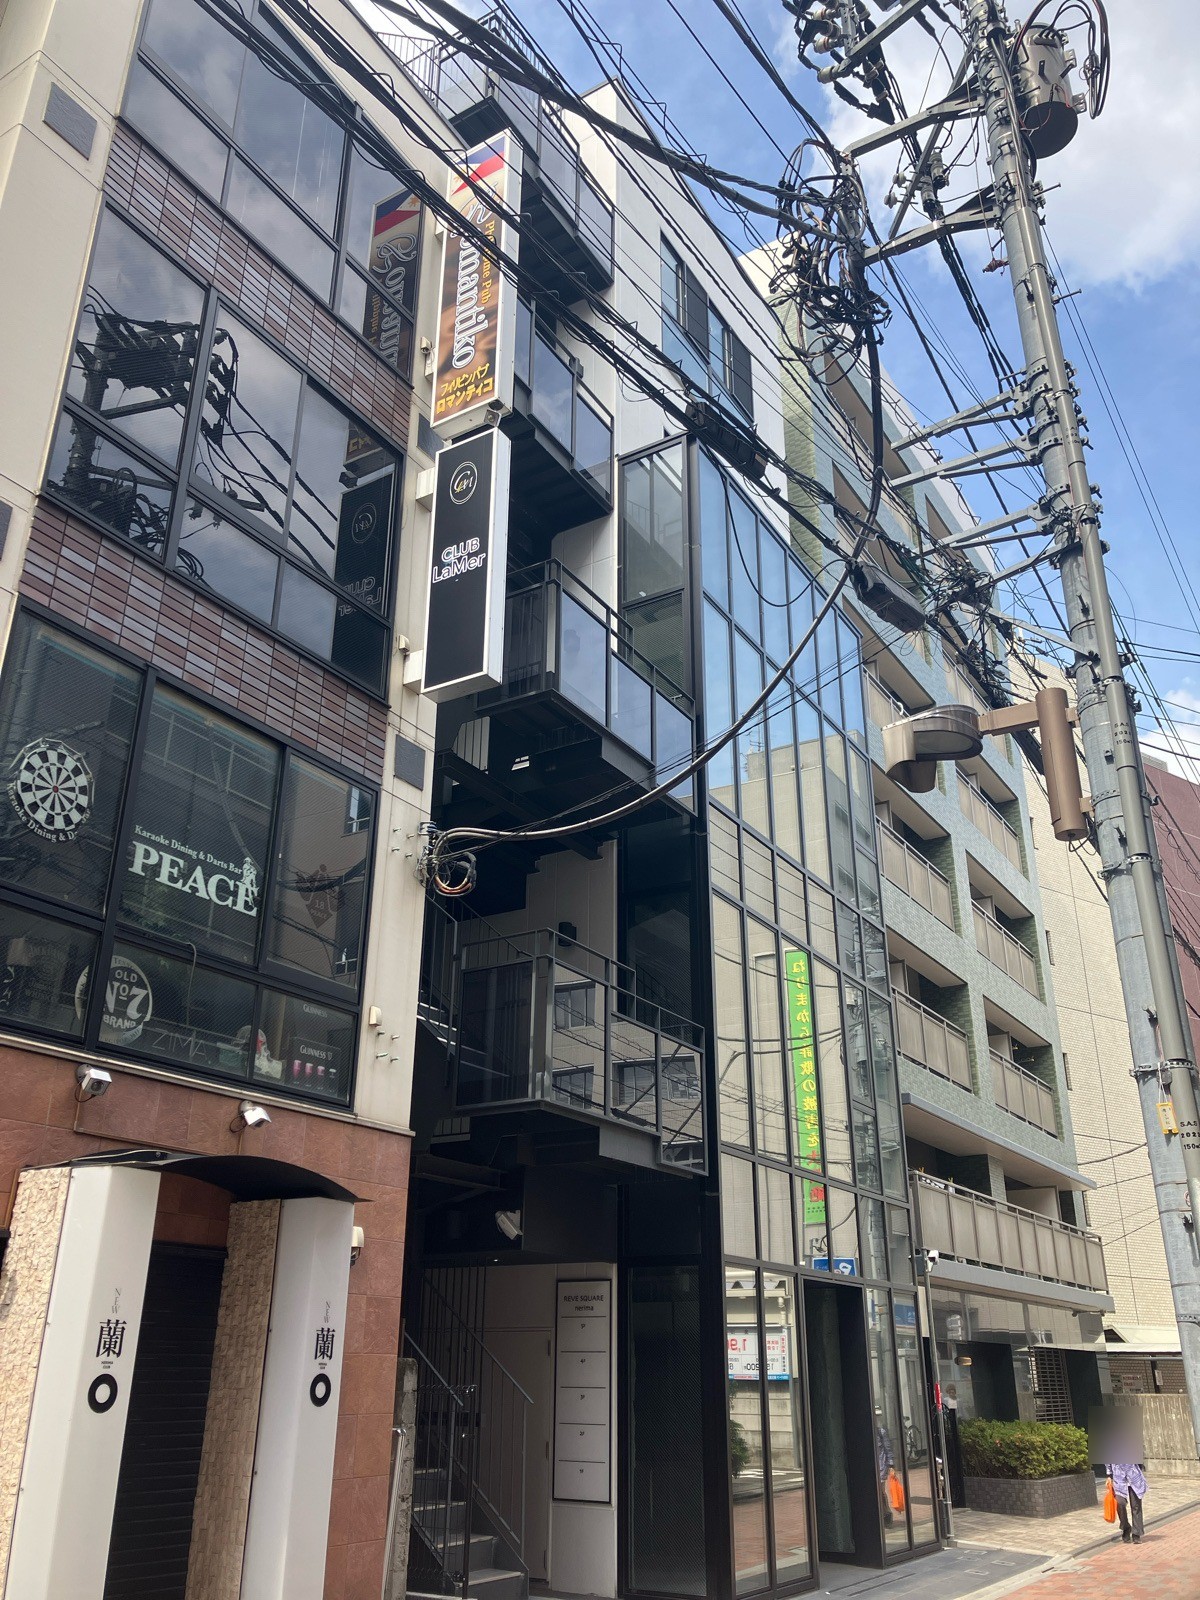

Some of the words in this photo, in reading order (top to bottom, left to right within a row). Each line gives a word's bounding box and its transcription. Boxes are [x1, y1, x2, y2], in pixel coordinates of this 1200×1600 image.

[481, 279, 492, 304] Pub
[436, 377, 494, 414] ロマンティコ
[440, 363, 490, 397] フィリピンパブ
[441, 537, 480, 563] CLUB
[432, 552, 487, 583] LaMer
[6, 781, 27, 822] Karaoke
[27, 819, 57, 843] Dining
[58, 832, 66, 841] &
[134, 824, 169, 846] Karaoke
[171, 839, 197, 859] Dining
[198, 851, 206, 860] &
[206, 854, 228, 869] Darts
[228, 862, 243, 874] Bar
[128, 840, 259, 917] PEACE
[115, 969, 138, 983] OLD
[103, 1015, 137, 1030] BRAND
[303, 1003, 328, 1018] GUINNESS
[152, 1031, 207, 1060] ZIMA
[300, 1044, 326, 1060] GUINNESS
[96, 1319, 127, 1358] 蘭
[314, 1327, 336, 1360] 蘭
